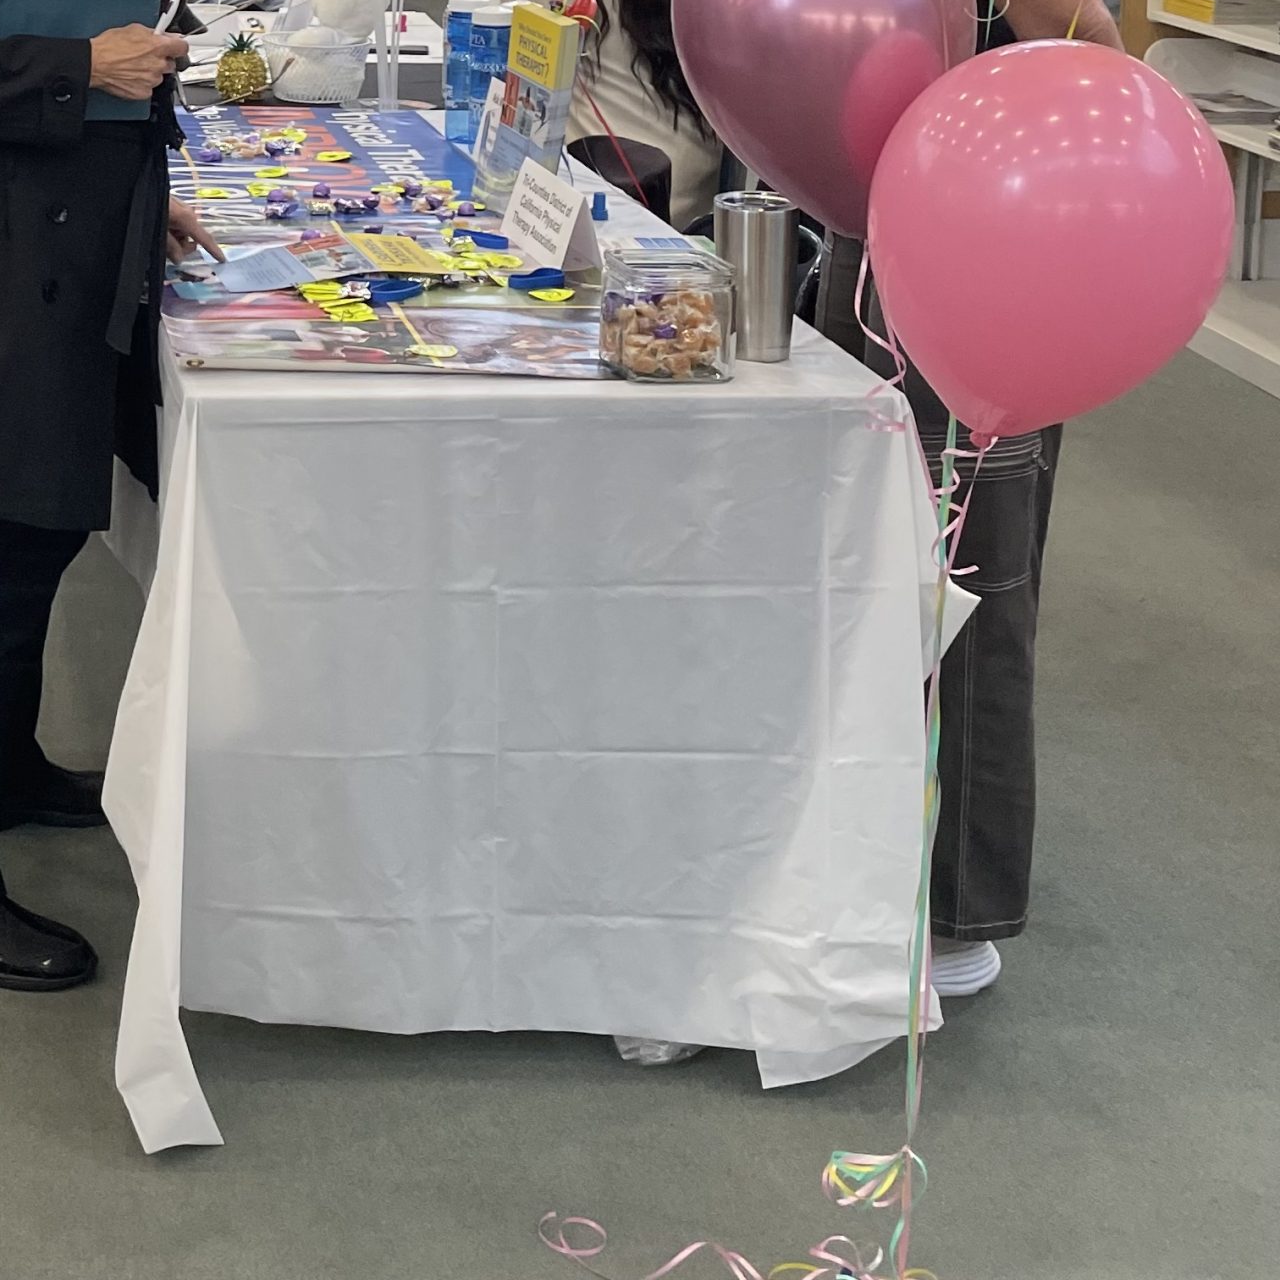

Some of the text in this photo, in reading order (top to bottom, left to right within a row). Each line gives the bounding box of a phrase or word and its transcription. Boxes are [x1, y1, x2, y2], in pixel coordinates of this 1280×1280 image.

[519, 34, 549, 60] PHYSICAL
[520, 194, 562, 234] California Physical
[549, 192, 567, 216] District
[512, 210, 557, 255] Therapy Association
